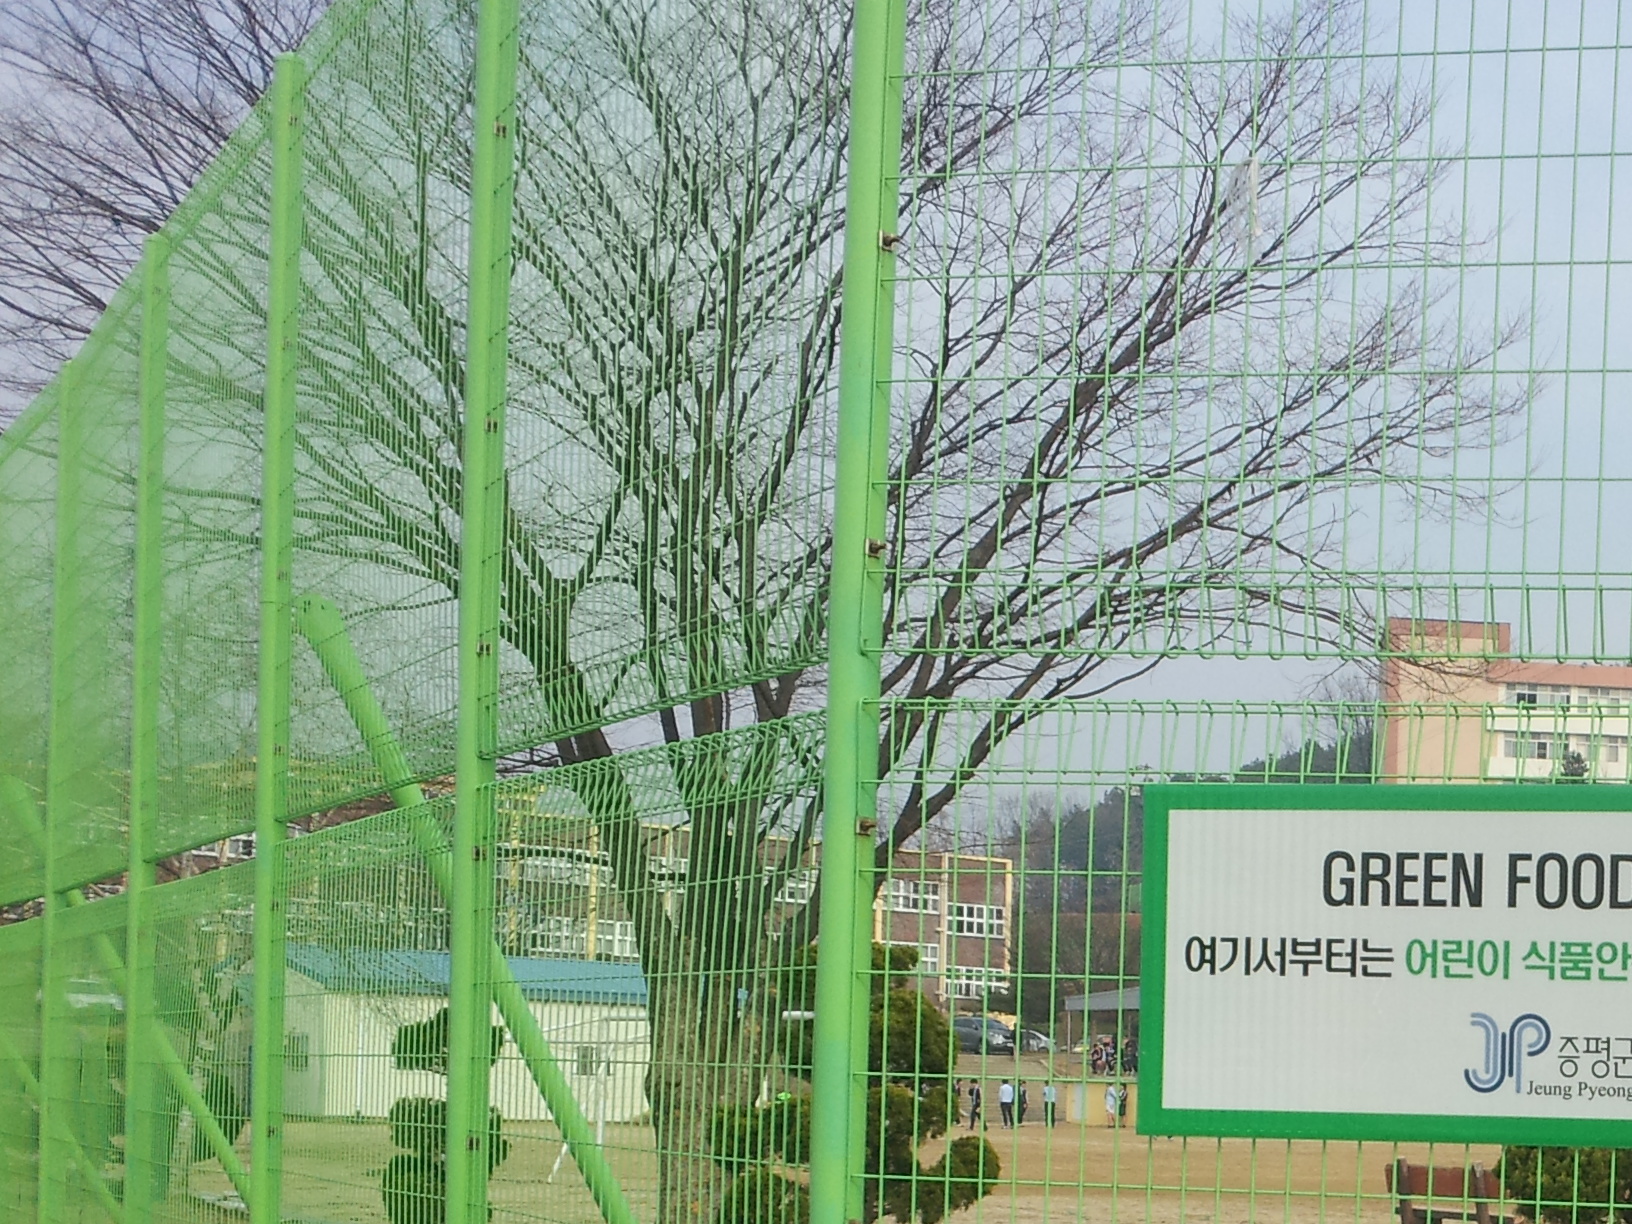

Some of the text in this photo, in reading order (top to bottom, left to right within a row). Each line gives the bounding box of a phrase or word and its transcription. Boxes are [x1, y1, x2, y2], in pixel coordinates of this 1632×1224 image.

[1323, 851, 1483, 907] GREEN
[1184, 935, 1394, 977] 여기서부터는
[1406, 939, 1510, 979] 어린이
[1526, 1080, 1572, 1099] Jeung
